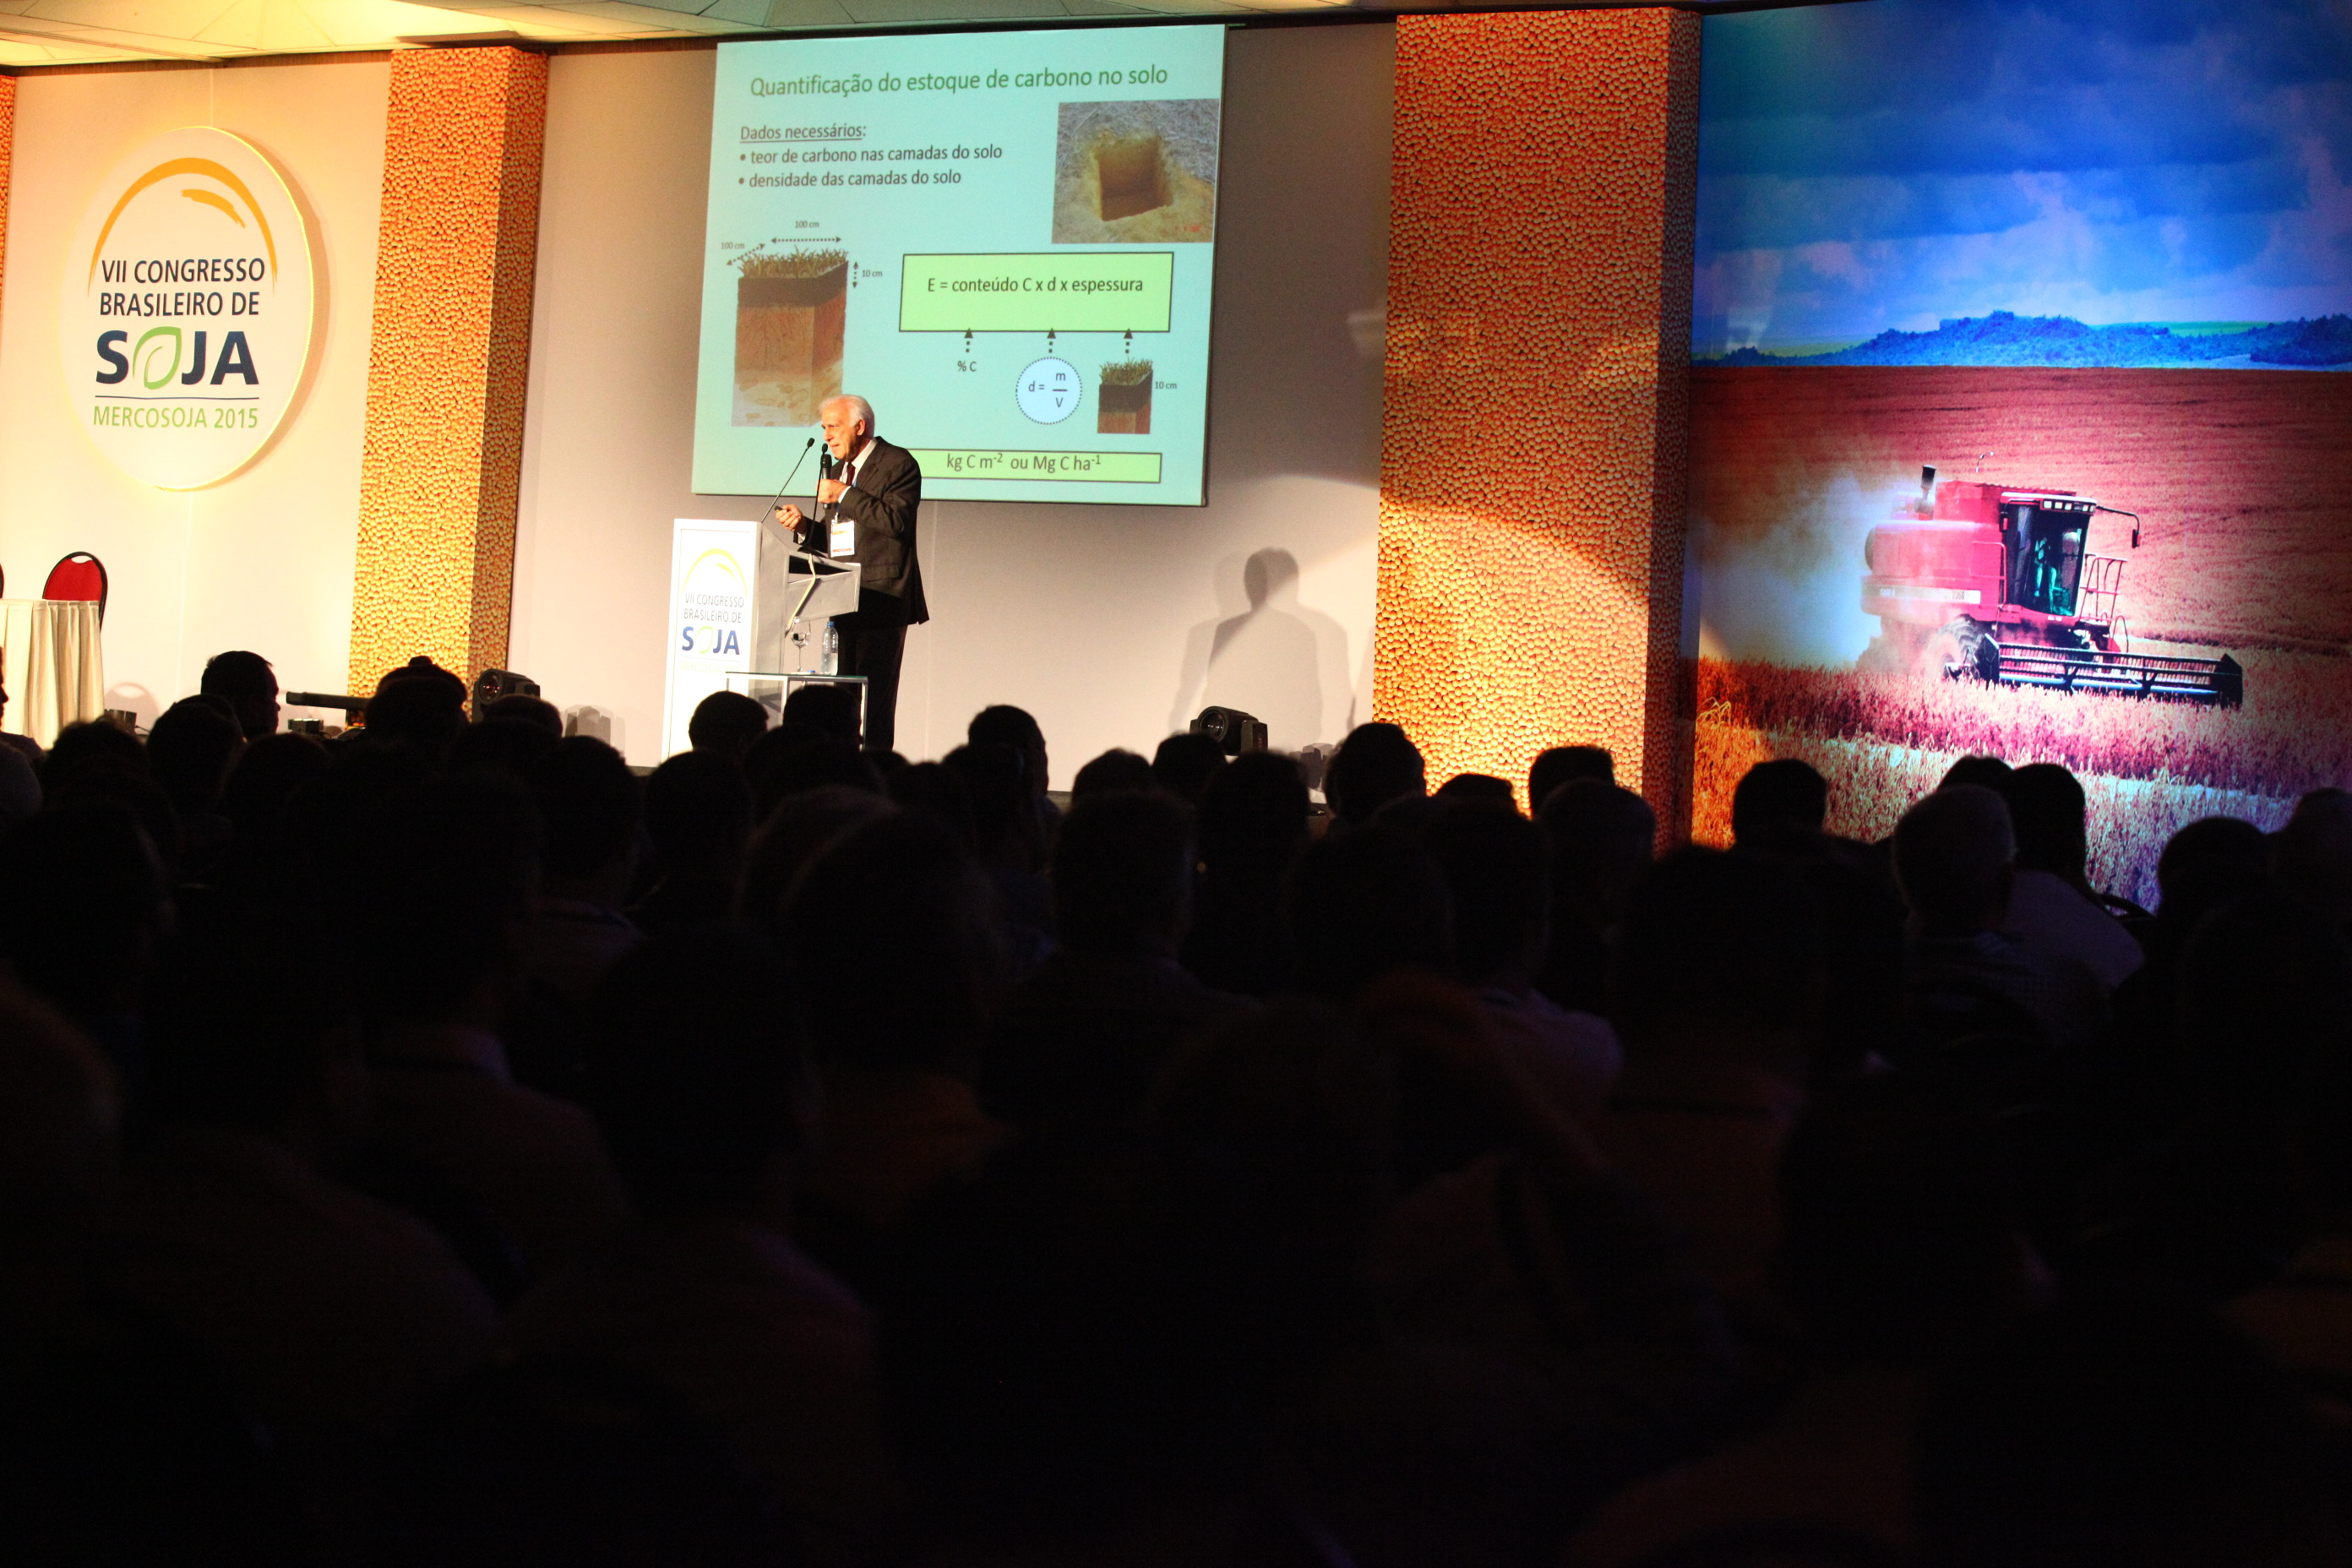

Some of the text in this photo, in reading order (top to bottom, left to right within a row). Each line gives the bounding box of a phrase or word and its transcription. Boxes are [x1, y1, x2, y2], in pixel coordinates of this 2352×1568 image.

[750, 63, 1168, 97] Quantificação do estoque de carbono no solo
[740, 123, 867, 140] Dados necessários:
[750, 143, 1003, 164] teor de carbono nas camadas do solo
[749, 168, 961, 188] densidade das camadas do solo
[794, 220, 808, 229] 100
[101, 258, 265, 284] VII CONGRESSO
[862, 270, 871, 278] 10
[928, 278, 935, 291] E
[951, 276, 1019, 292] conteúdo
[1022, 277, 1032, 291] C
[1035, 280, 1043, 291] x
[1047, 276, 1056, 291] d
[1059, 280, 1068, 291] x
[1071, 279, 1144, 295] espessura
[100, 291, 260, 317] BRASILEIRO DE
[95, 326, 259, 389] SOJA
[957, 361, 977, 372] % C
[1055, 372, 1066, 382] m
[1155, 381, 1164, 389] 10
[1027, 381, 1036, 392] d
[1055, 397, 1064, 408] V
[94, 406, 259, 429] MERCOSOJA 2015
[946, 453, 962, 471] kg
[966, 455, 977, 468] C
[1010, 458, 1029, 470] ou
[1032, 455, 1056, 473] Mg
[1059, 456, 1070, 471] C
[685, 593, 744, 608] VII CONGRESSO
[683, 607, 742, 623] BRASILEIRO DE
[681, 625, 741, 656] SOJA
